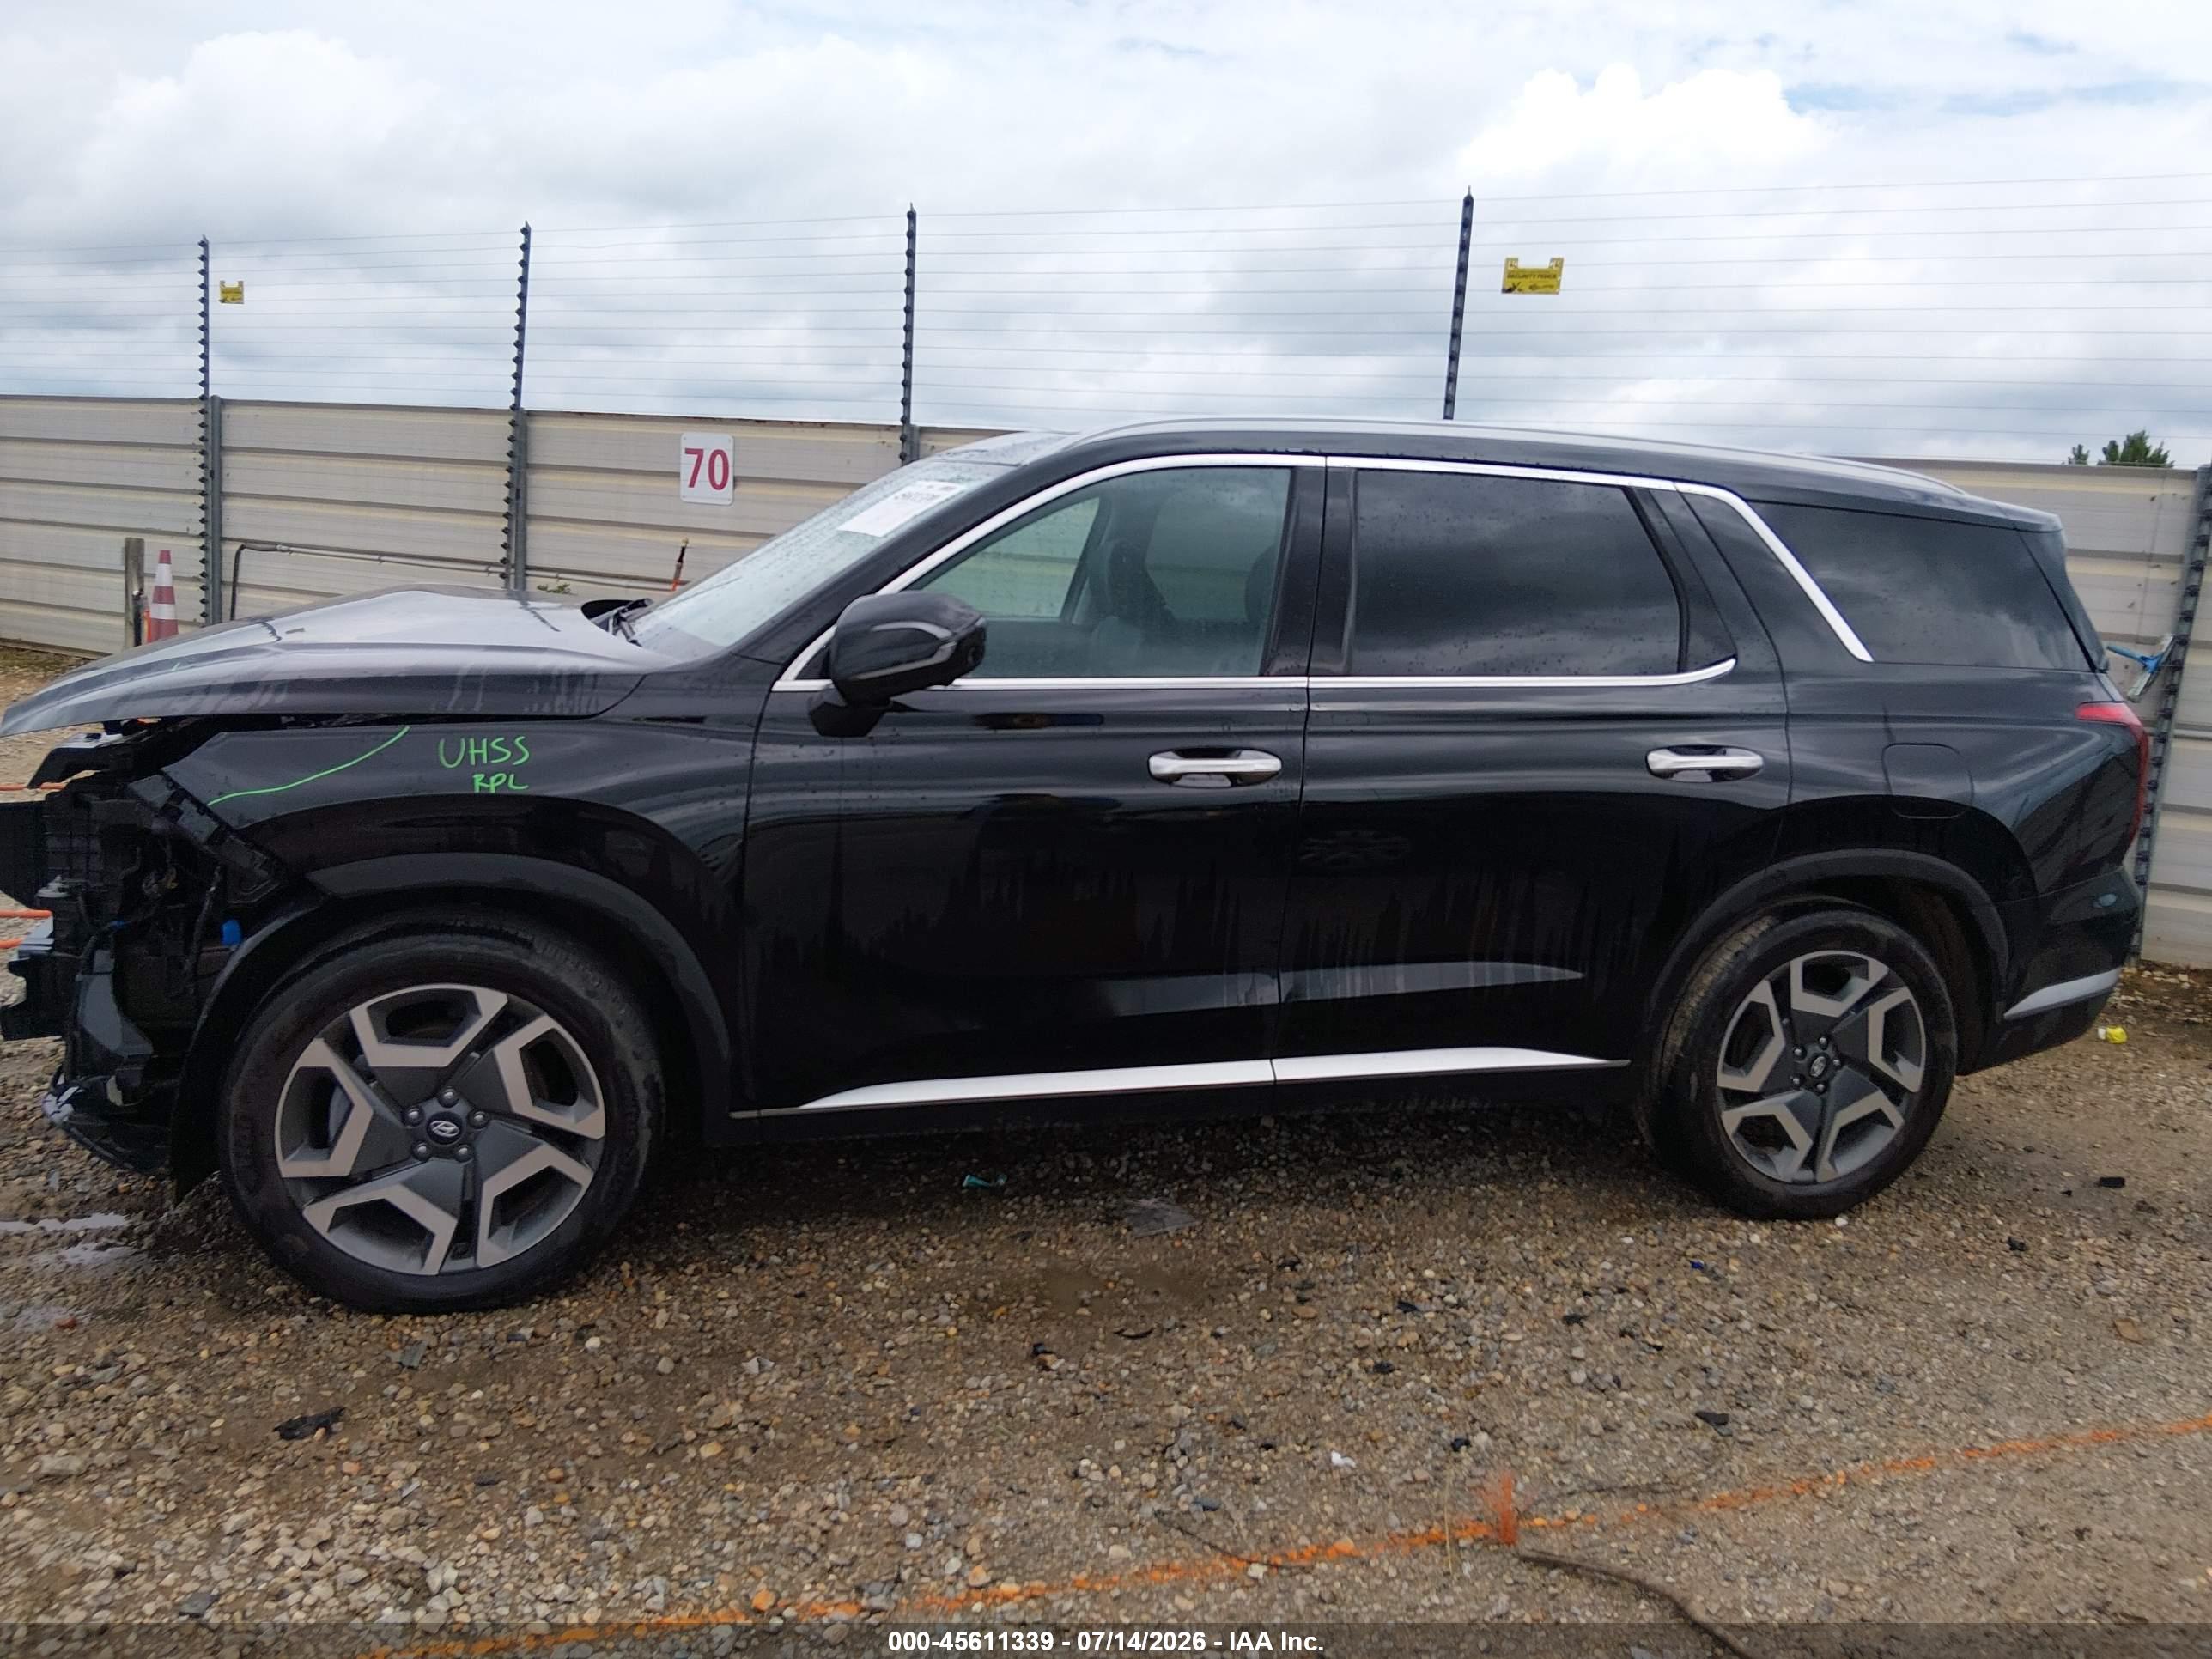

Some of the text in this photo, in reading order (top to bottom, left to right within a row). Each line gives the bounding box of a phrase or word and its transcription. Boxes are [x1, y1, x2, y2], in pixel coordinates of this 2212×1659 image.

[684, 447, 729, 490] 70
[438, 736, 530, 769] UHSS
[472, 773, 529, 793] RPL
